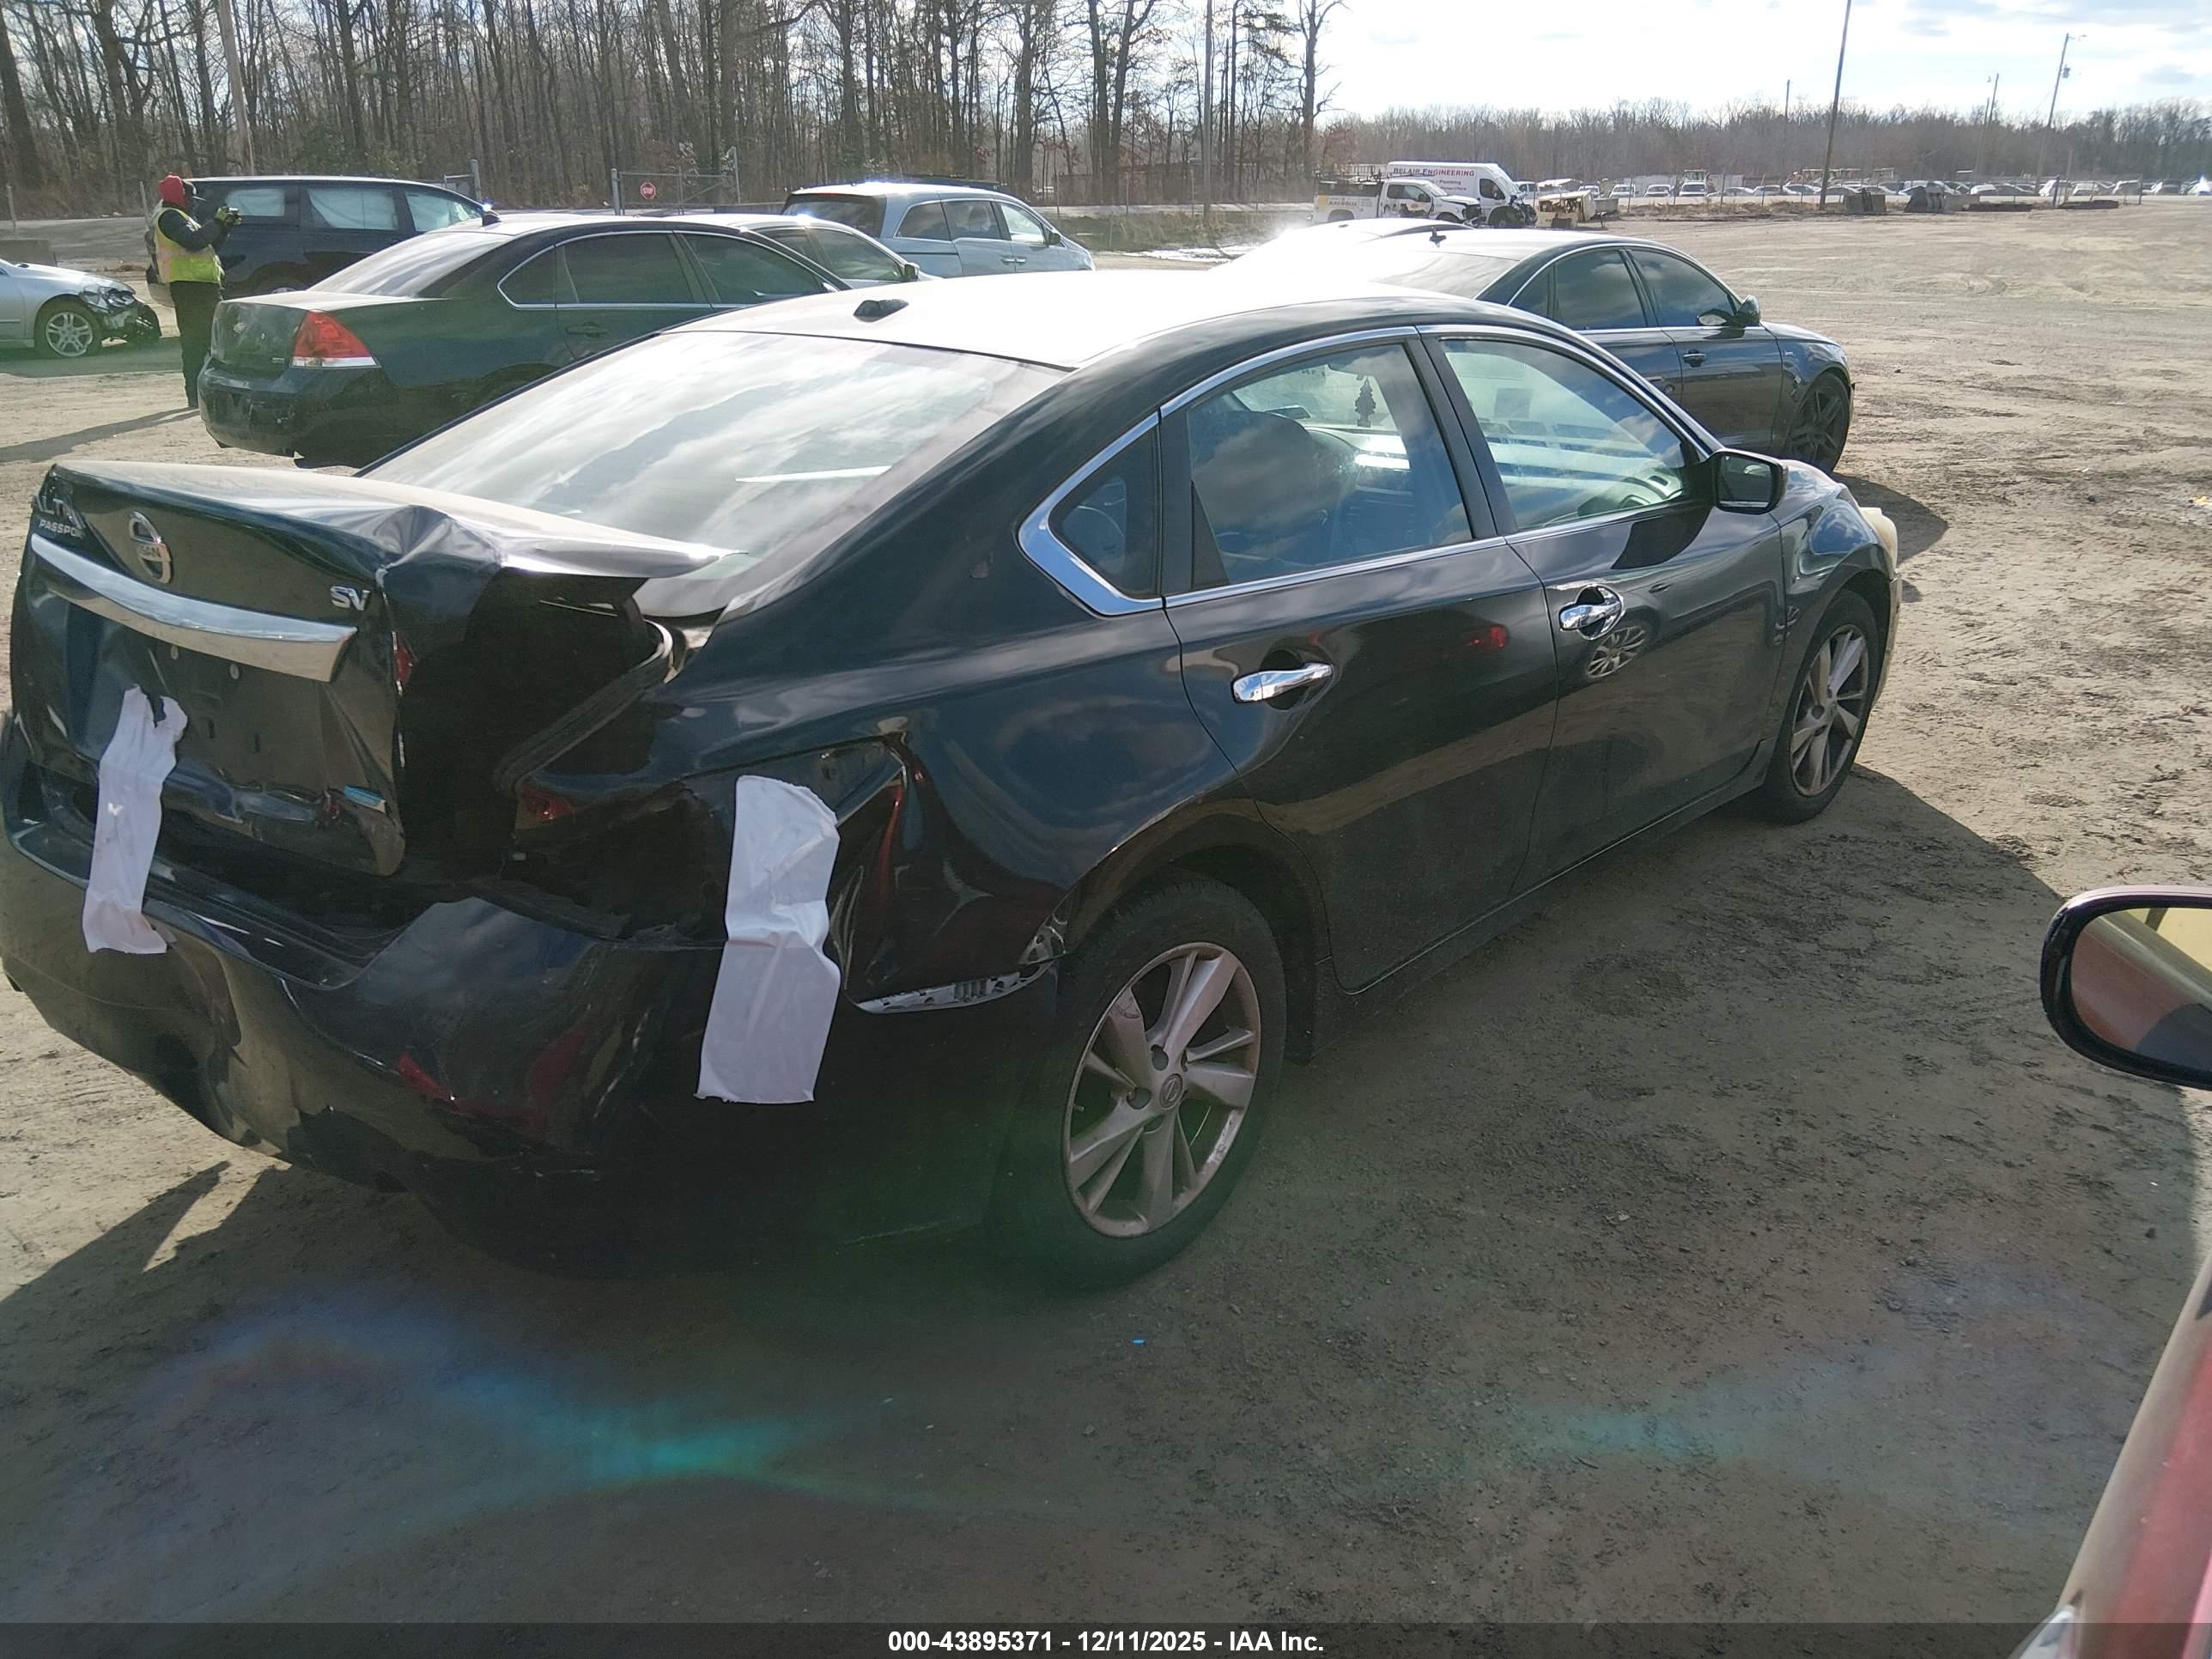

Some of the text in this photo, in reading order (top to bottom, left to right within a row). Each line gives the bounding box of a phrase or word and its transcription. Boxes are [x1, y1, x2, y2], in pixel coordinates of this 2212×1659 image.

[1422, 168, 1475, 177] ENGINEERING
[40, 519, 82, 539] PASSPO
[330, 586, 371, 611] SV
